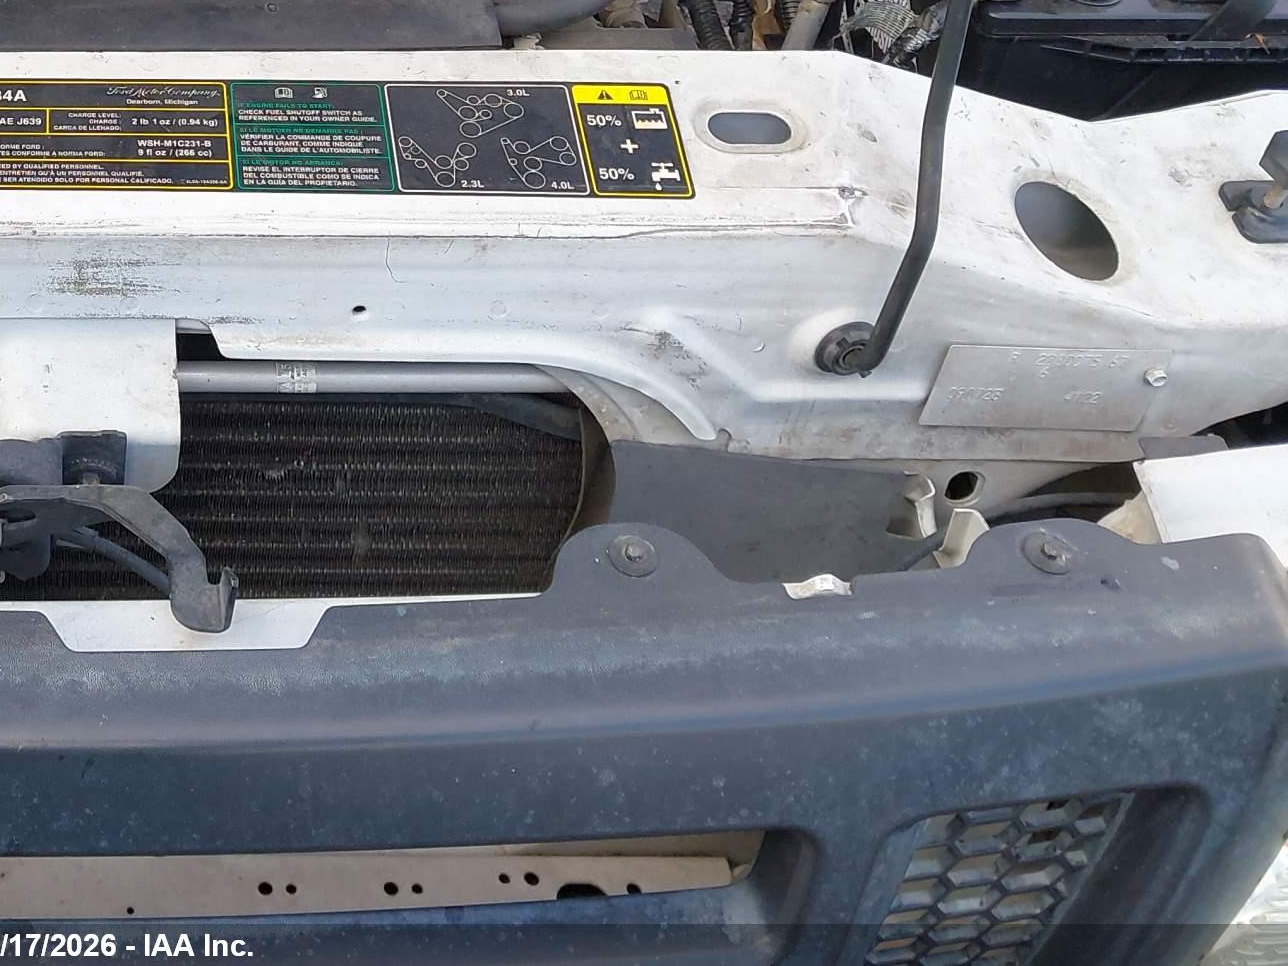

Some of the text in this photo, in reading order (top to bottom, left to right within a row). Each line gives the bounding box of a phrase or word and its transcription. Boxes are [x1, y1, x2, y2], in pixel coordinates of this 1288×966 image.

[507, 89, 530, 97] 3.0L
[17, 117, 42, 126] J639
[131, 118, 138, 126] 2
[140, 118, 149, 126] lb
[178, 118, 201, 127] (0.94
[203, 118, 219, 128] kg)
[586, 114, 622, 127] 50%
[137, 139, 212, 147] WSH-M1C231-B
[198, 149, 212, 157] cc)
[599, 167, 635, 181] 50%
[461, 180, 484, 188] 2.3L
[551, 181, 575, 189] 4.0L
